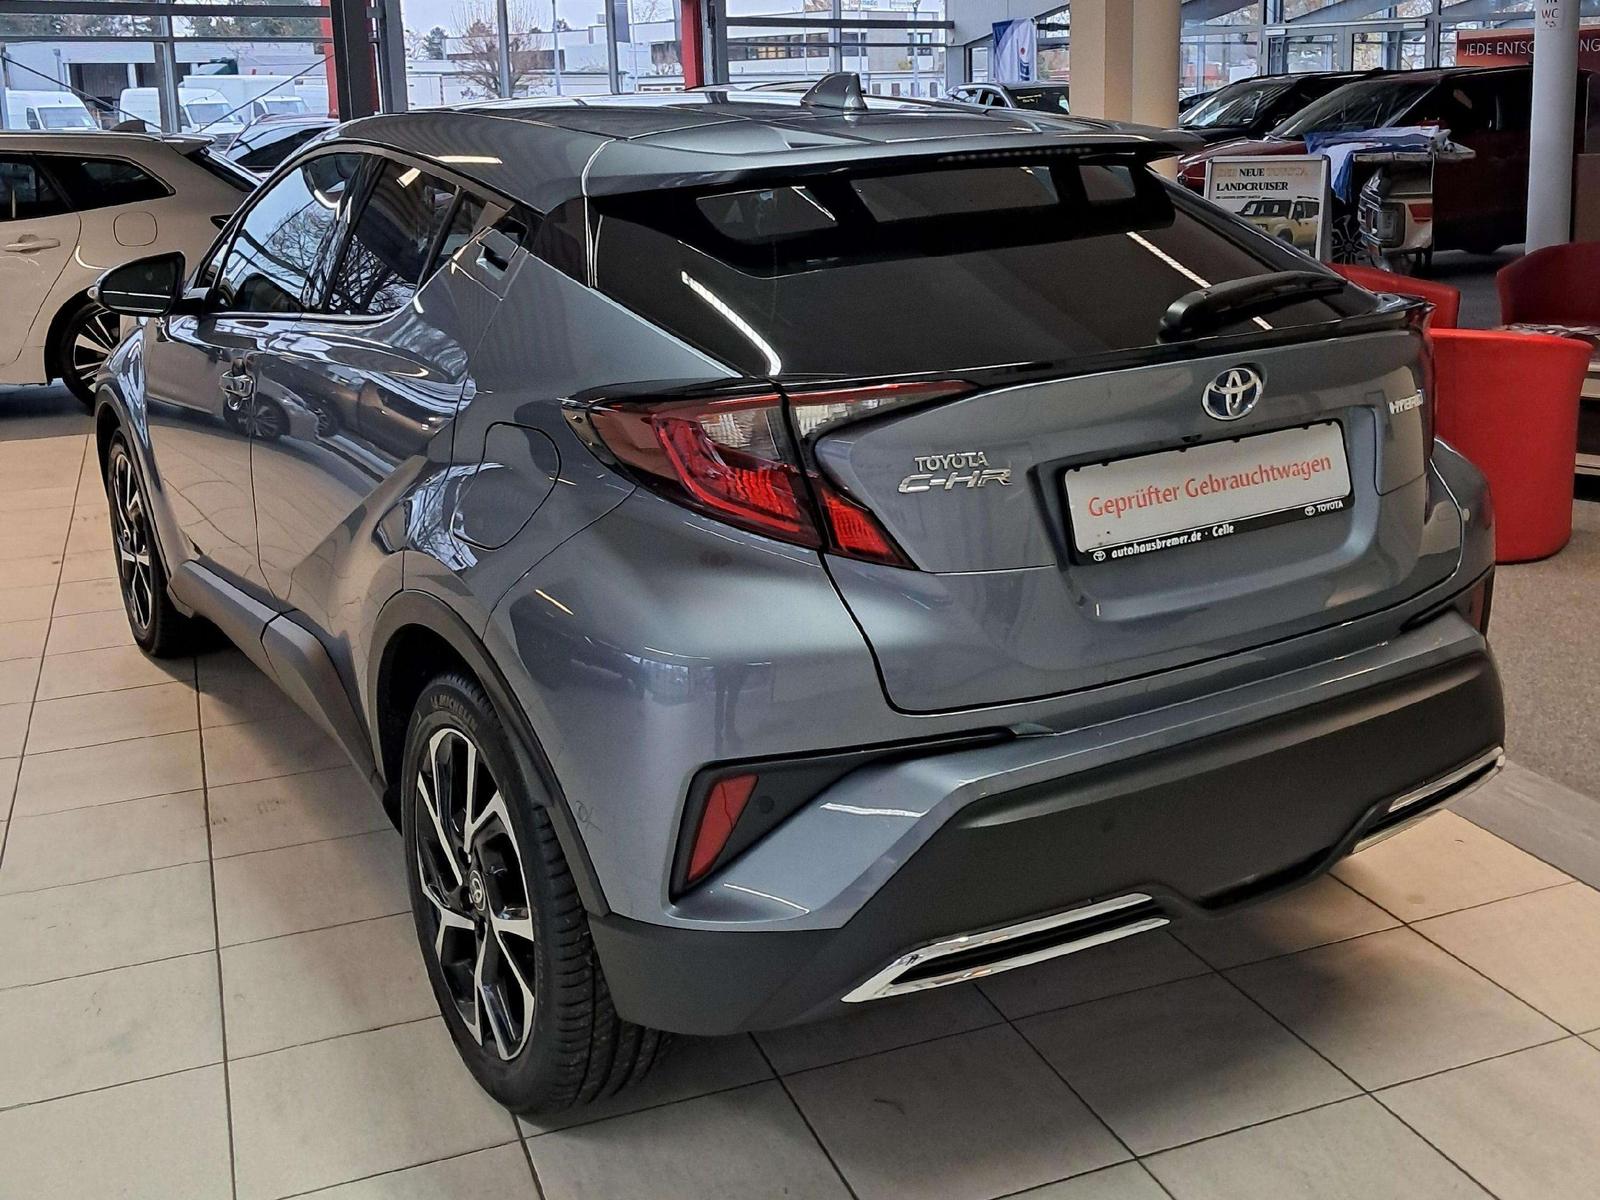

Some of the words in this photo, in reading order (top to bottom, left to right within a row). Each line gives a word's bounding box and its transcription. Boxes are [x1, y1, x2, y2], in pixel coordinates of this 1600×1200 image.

[1541, 8, 1559, 19] WC
[1464, 42, 1492, 57] JEDE
[1239, 168, 1265, 177] NEUE
[1216, 181, 1289, 191] LANDCRUISER
[914, 451, 989, 472] TOYOTA
[898, 468, 1013, 494] C-HR
[1087, 485, 1180, 519] Geprüfter
[1184, 455, 1333, 498] Gebrauchtwagen
[1316, 500, 1344, 513] TOYOTA
[1111, 532, 1202, 559] autohausbremer.de
[1212, 523, 1235, 537] Celle
